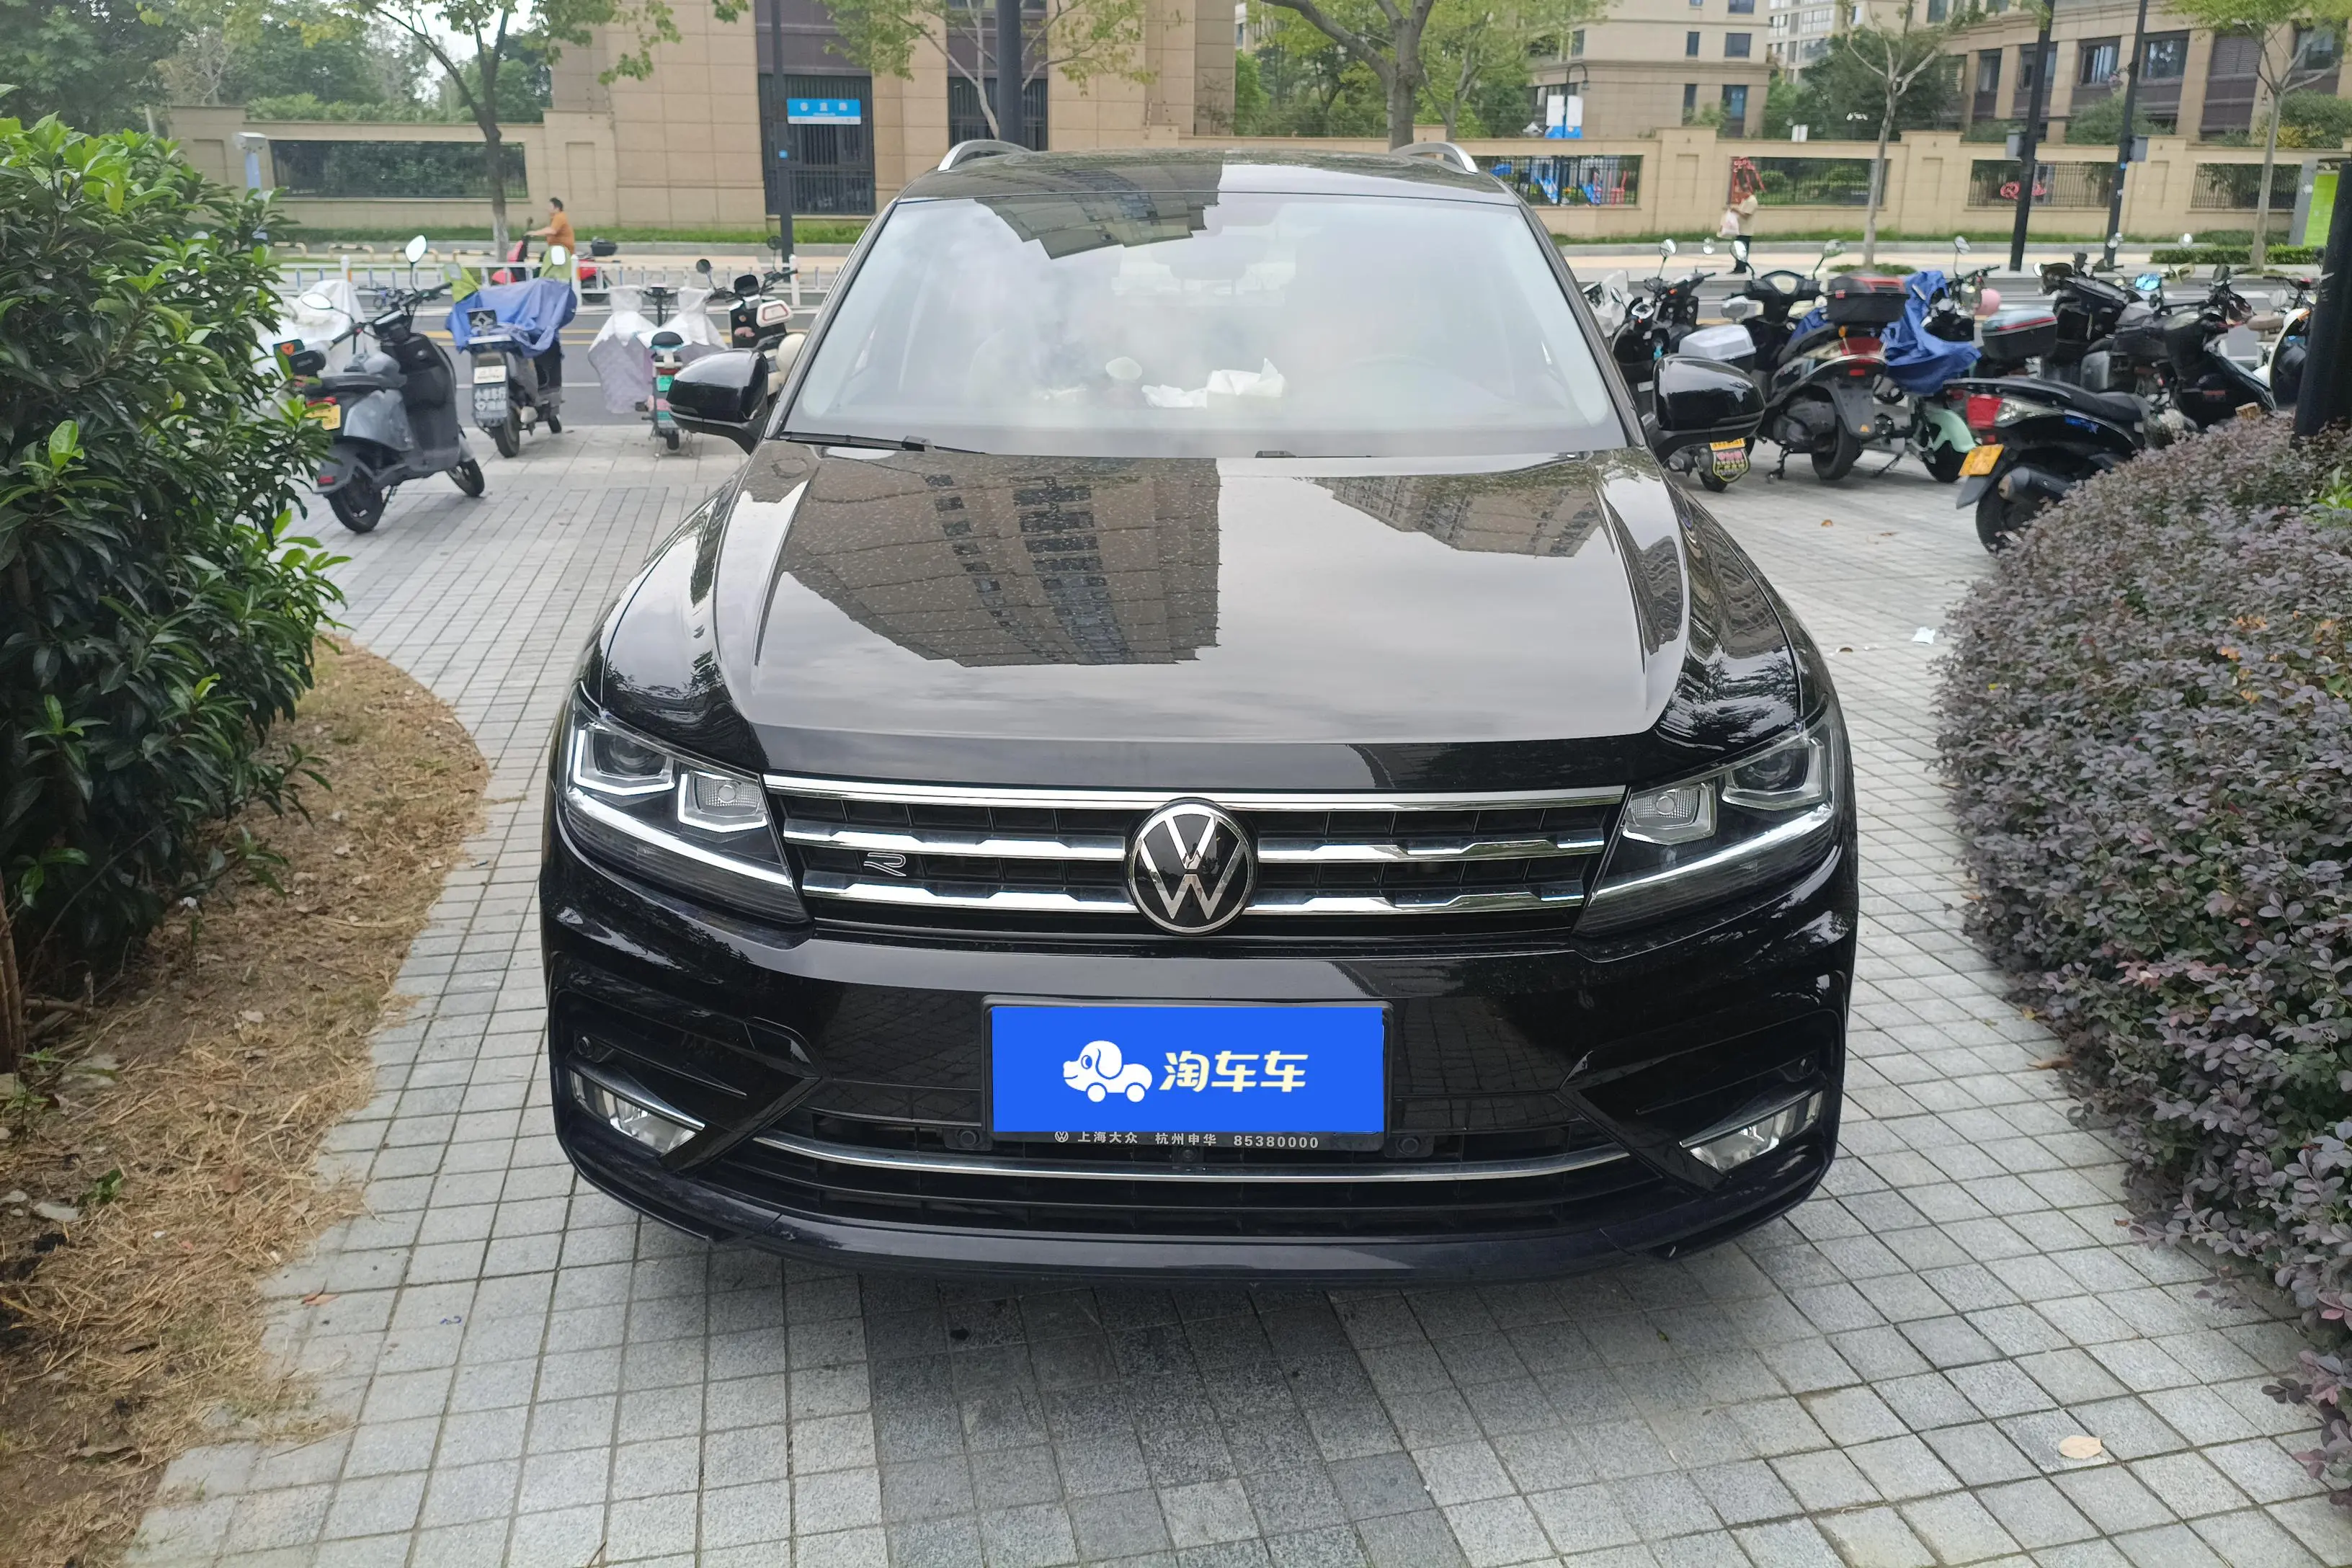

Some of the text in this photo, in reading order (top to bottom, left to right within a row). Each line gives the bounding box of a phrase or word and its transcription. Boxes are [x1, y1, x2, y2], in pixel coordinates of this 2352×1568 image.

[1078, 1131, 1138, 1144] 上海大众
[1155, 1133, 1216, 1146] 杭州申华
[1234, 1135, 1319, 1149] 85380000
